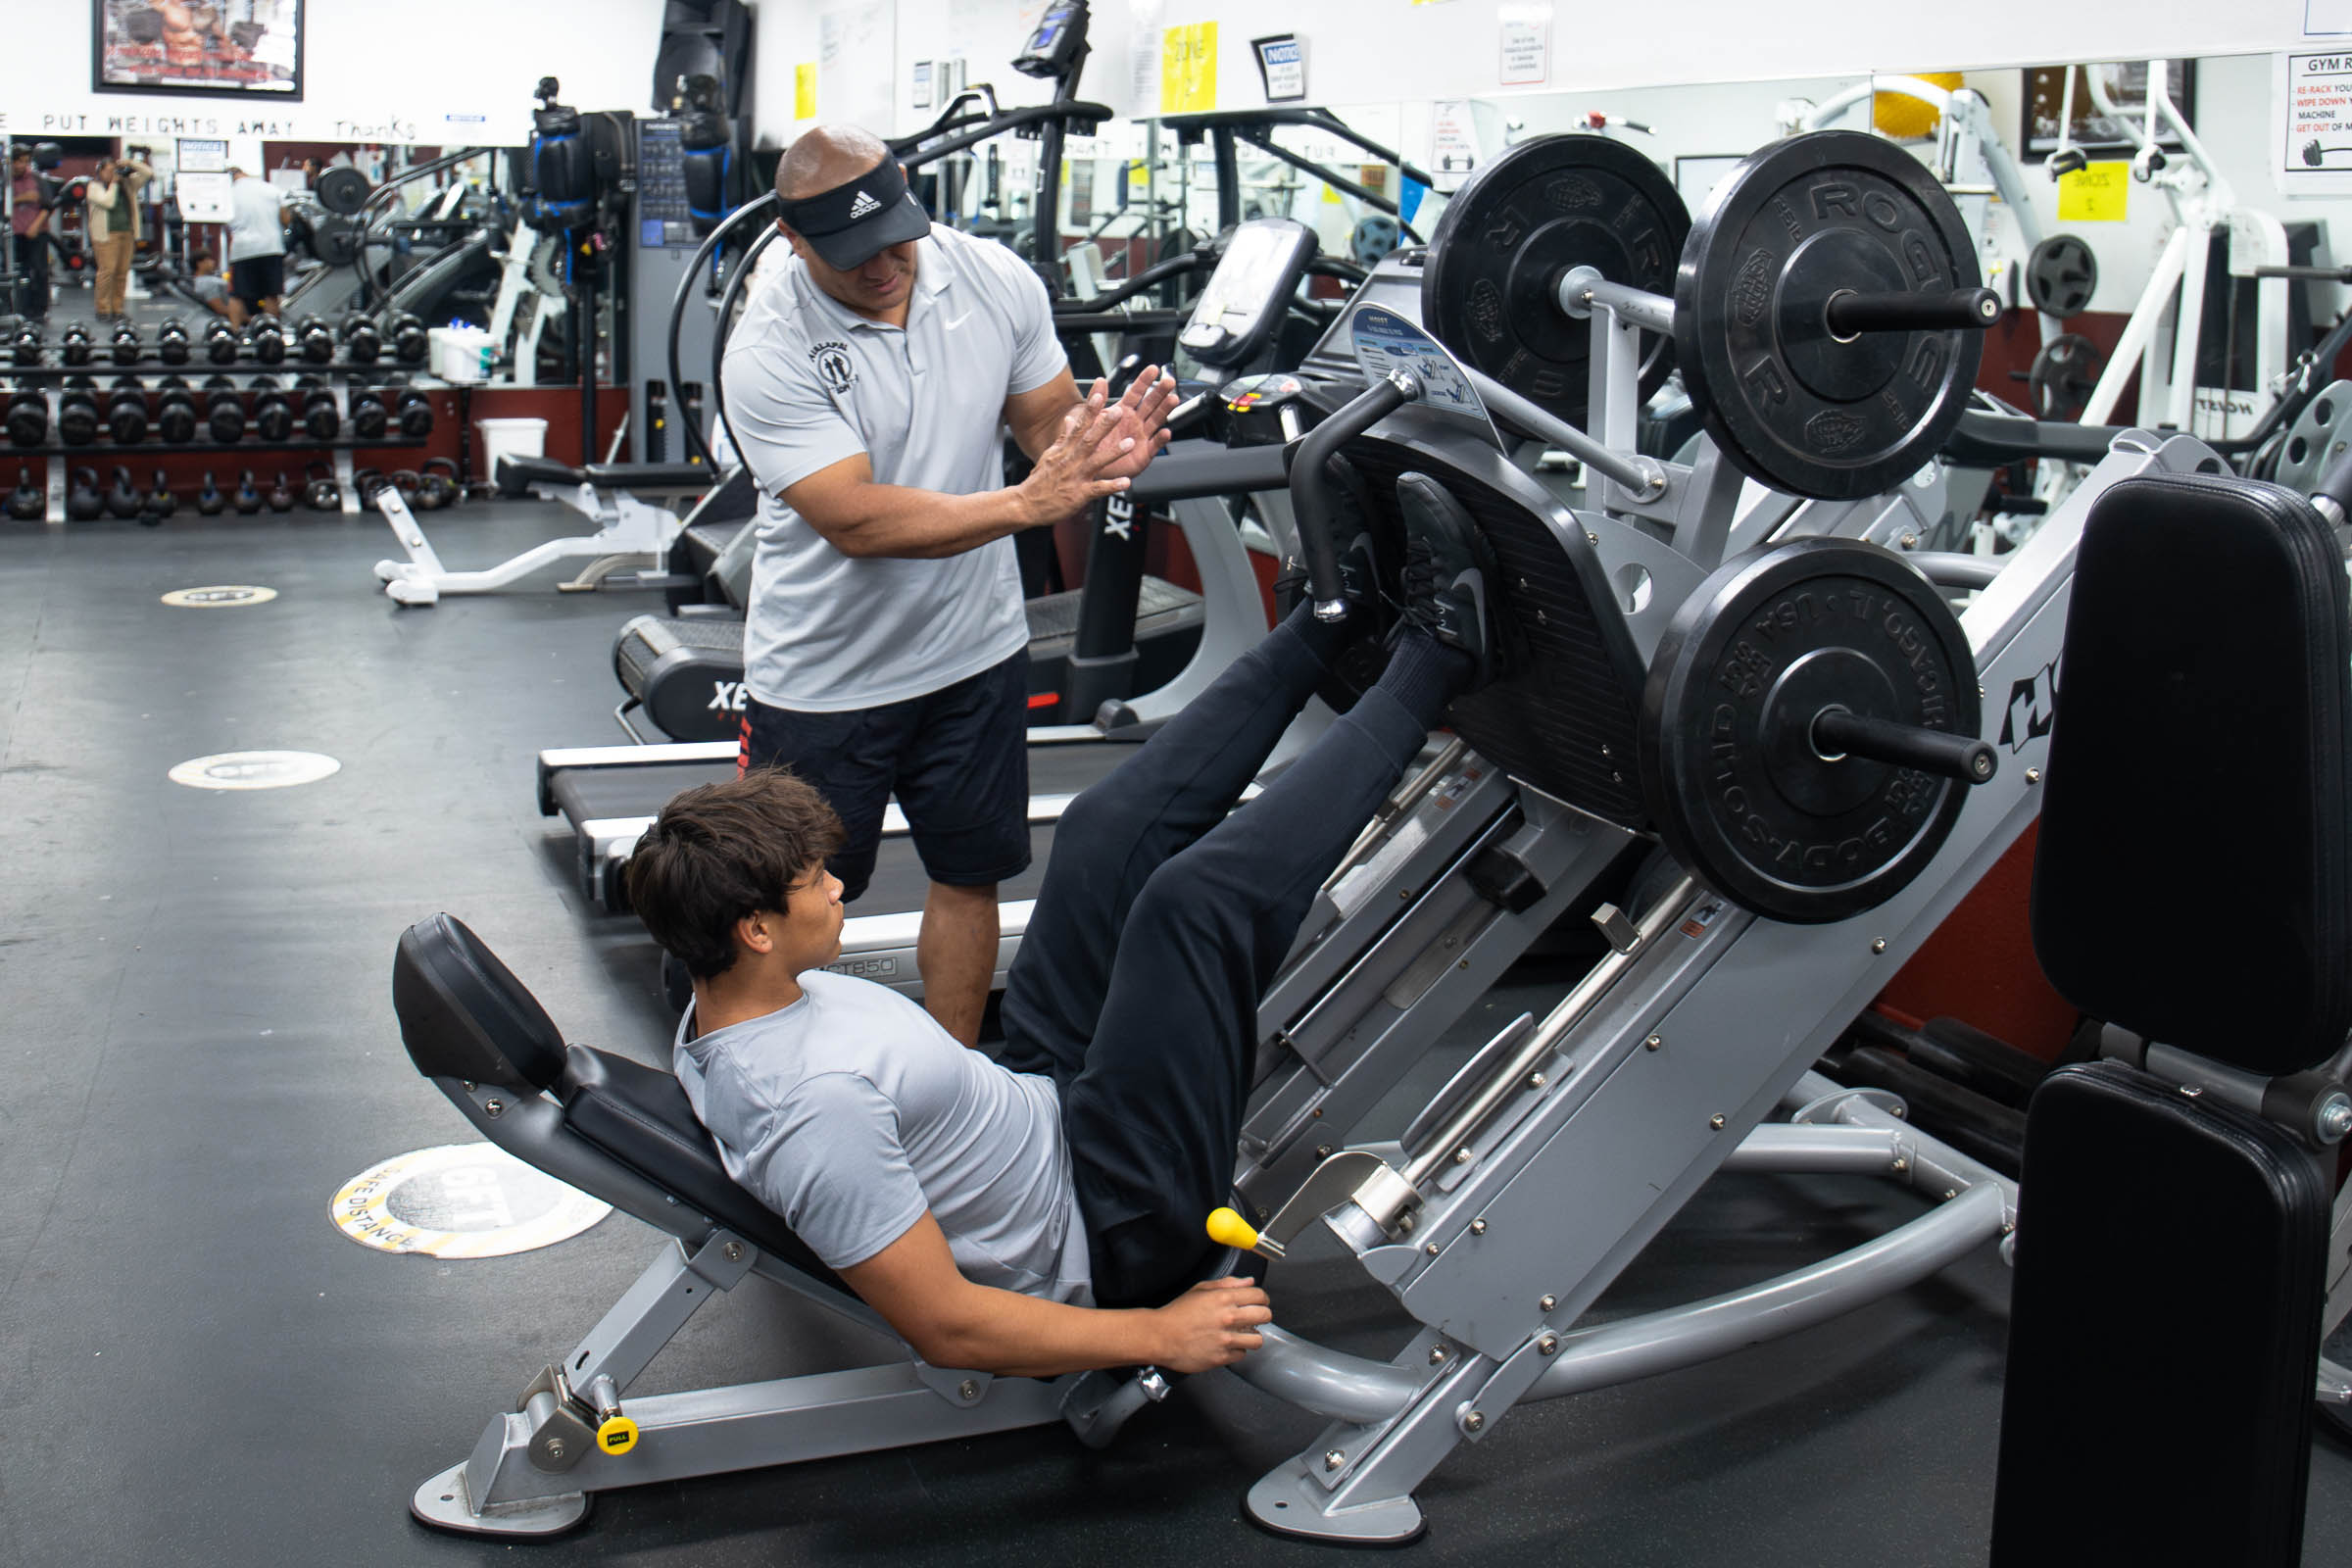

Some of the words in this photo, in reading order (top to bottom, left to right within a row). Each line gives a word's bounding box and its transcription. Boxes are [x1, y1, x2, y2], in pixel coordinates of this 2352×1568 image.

[2308, 58, 2340, 72] GYM
[2297, 85, 2332, 95] RE-RACK
[2319, 97, 2346, 107] DOWN
[43, 115, 87, 130] PUT
[108, 116, 219, 134] WEIGHTS
[238, 121, 292, 135] AWAY
[334, 116, 416, 141] Thanks
[2297, 123, 2311, 132] GET
[2314, 122, 2329, 131] OUT
[2331, 122, 2342, 131] OF
[850, 200, 881, 219] adidas
[1810, 181, 1945, 389] ROGE
[349, 1197, 414, 1248] DISTANCE
[609, 1434, 627, 1443] PULL
